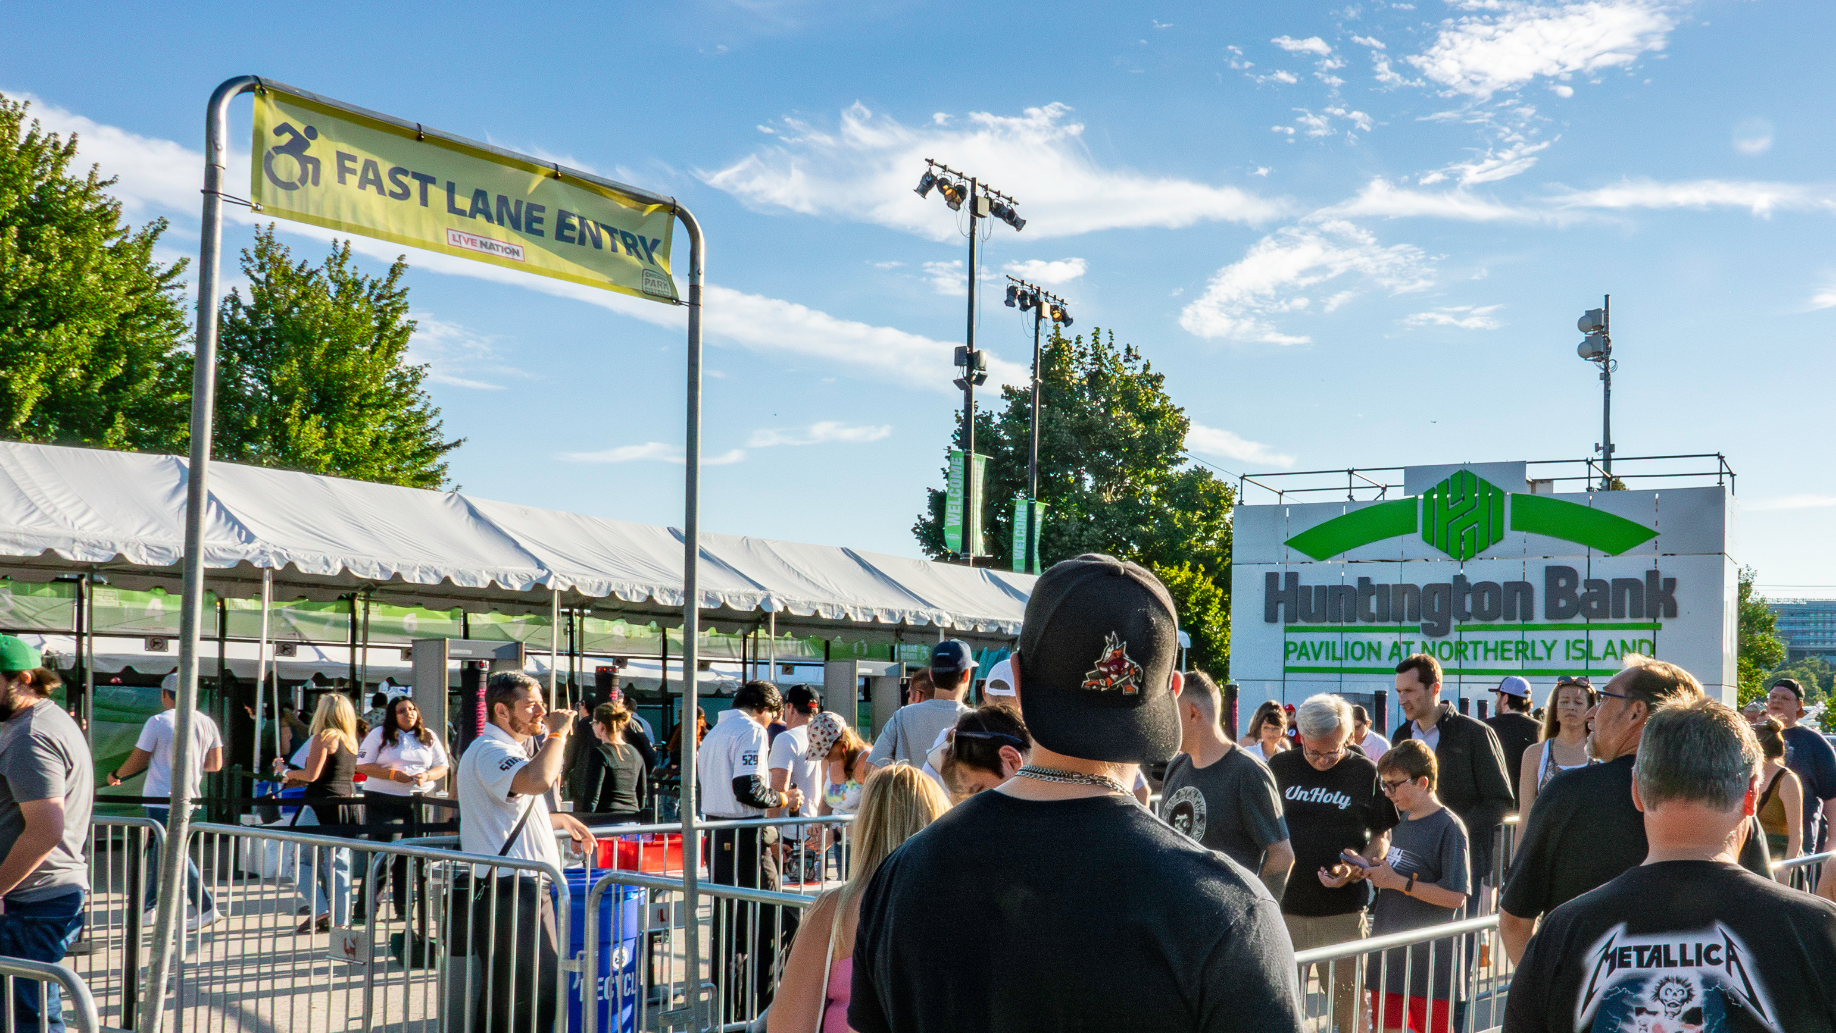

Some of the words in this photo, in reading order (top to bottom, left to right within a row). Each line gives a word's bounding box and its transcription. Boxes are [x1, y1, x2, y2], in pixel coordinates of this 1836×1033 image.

[336, 150, 437, 207] FAST
[446, 180, 546, 237] LANE
[555, 208, 661, 265] ENTRY
[452, 233, 478, 247] LIVE
[480, 240, 521, 257] NATION
[644, 278, 669, 290] PARK
[946, 457, 963, 527] WELCOME
[1013, 504, 1027, 560] WELCOME
[1264, 571, 1534, 638] Huntington
[1544, 565, 1678, 620] Bank
[1285, 640, 1382, 661] PAVILION
[1388, 640, 1415, 661] AT
[1421, 639, 1558, 661] NORTHERLY
[1565, 638, 1654, 661] ISLAND
[742, 754, 759, 766] 529
[1285, 785, 1351, 810] UnHoly
[1579, 925, 1774, 1025] METALLICA
